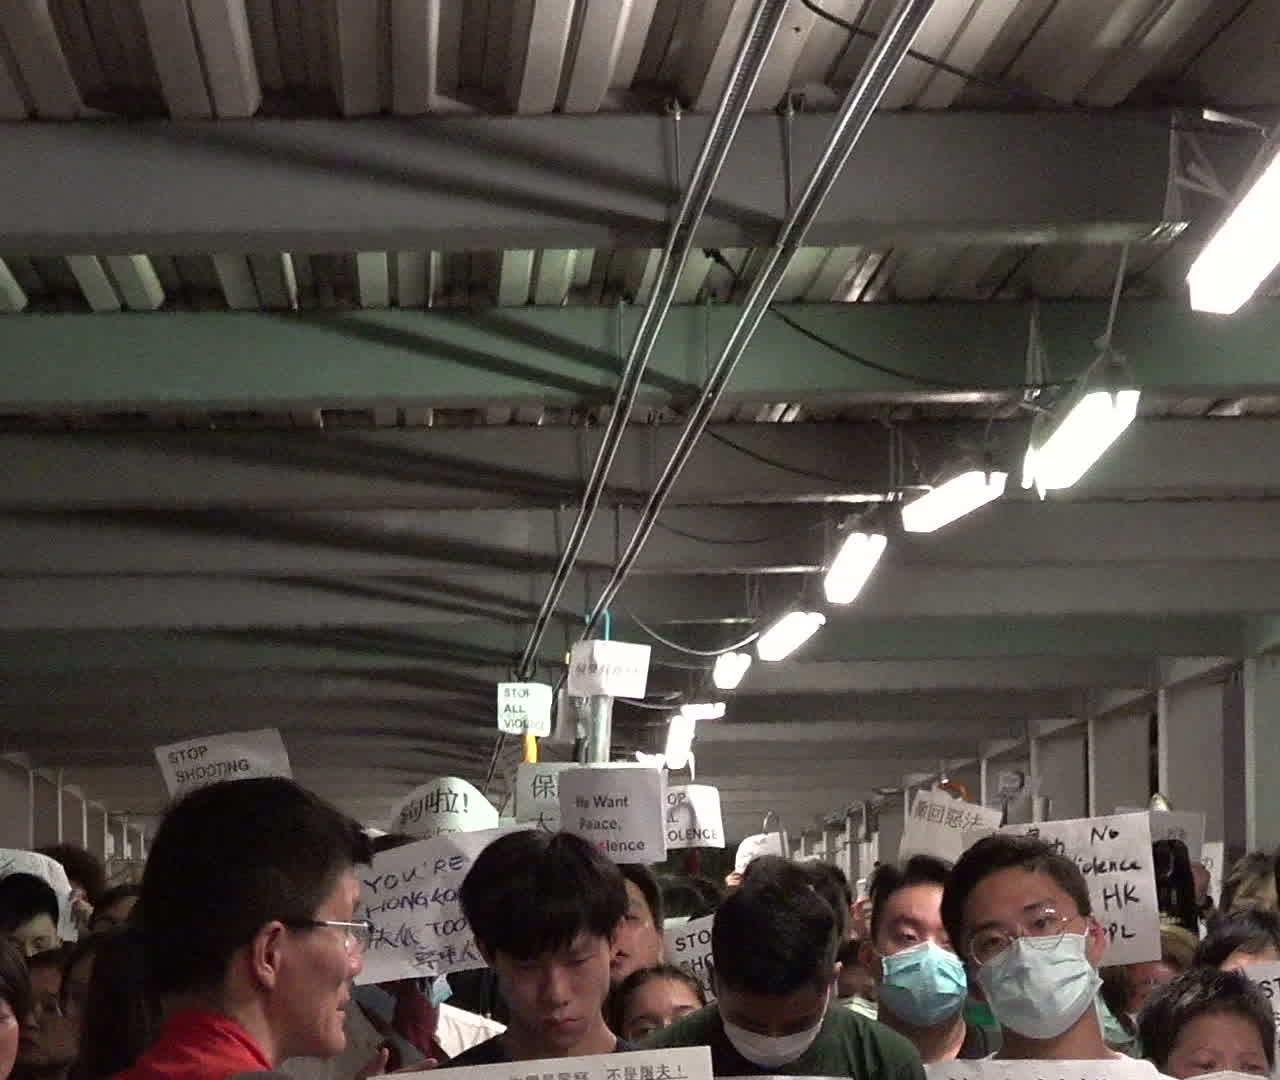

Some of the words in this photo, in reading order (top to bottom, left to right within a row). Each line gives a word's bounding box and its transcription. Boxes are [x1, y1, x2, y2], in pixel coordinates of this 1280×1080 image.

[503, 703, 526, 714] ALL
[167, 745, 209, 764] STOP
[175, 759, 250, 783] SHOOTING
[531, 773, 556, 800] 保
[593, 795, 630, 809] Want
[667, 792, 687, 807] OP
[667, 828, 718, 842] OLENCE
[1089, 825, 1120, 846] No
[365, 887, 465, 919] HONGKO
[1102, 882, 1140, 910] HK
[675, 929, 711, 952] STO
